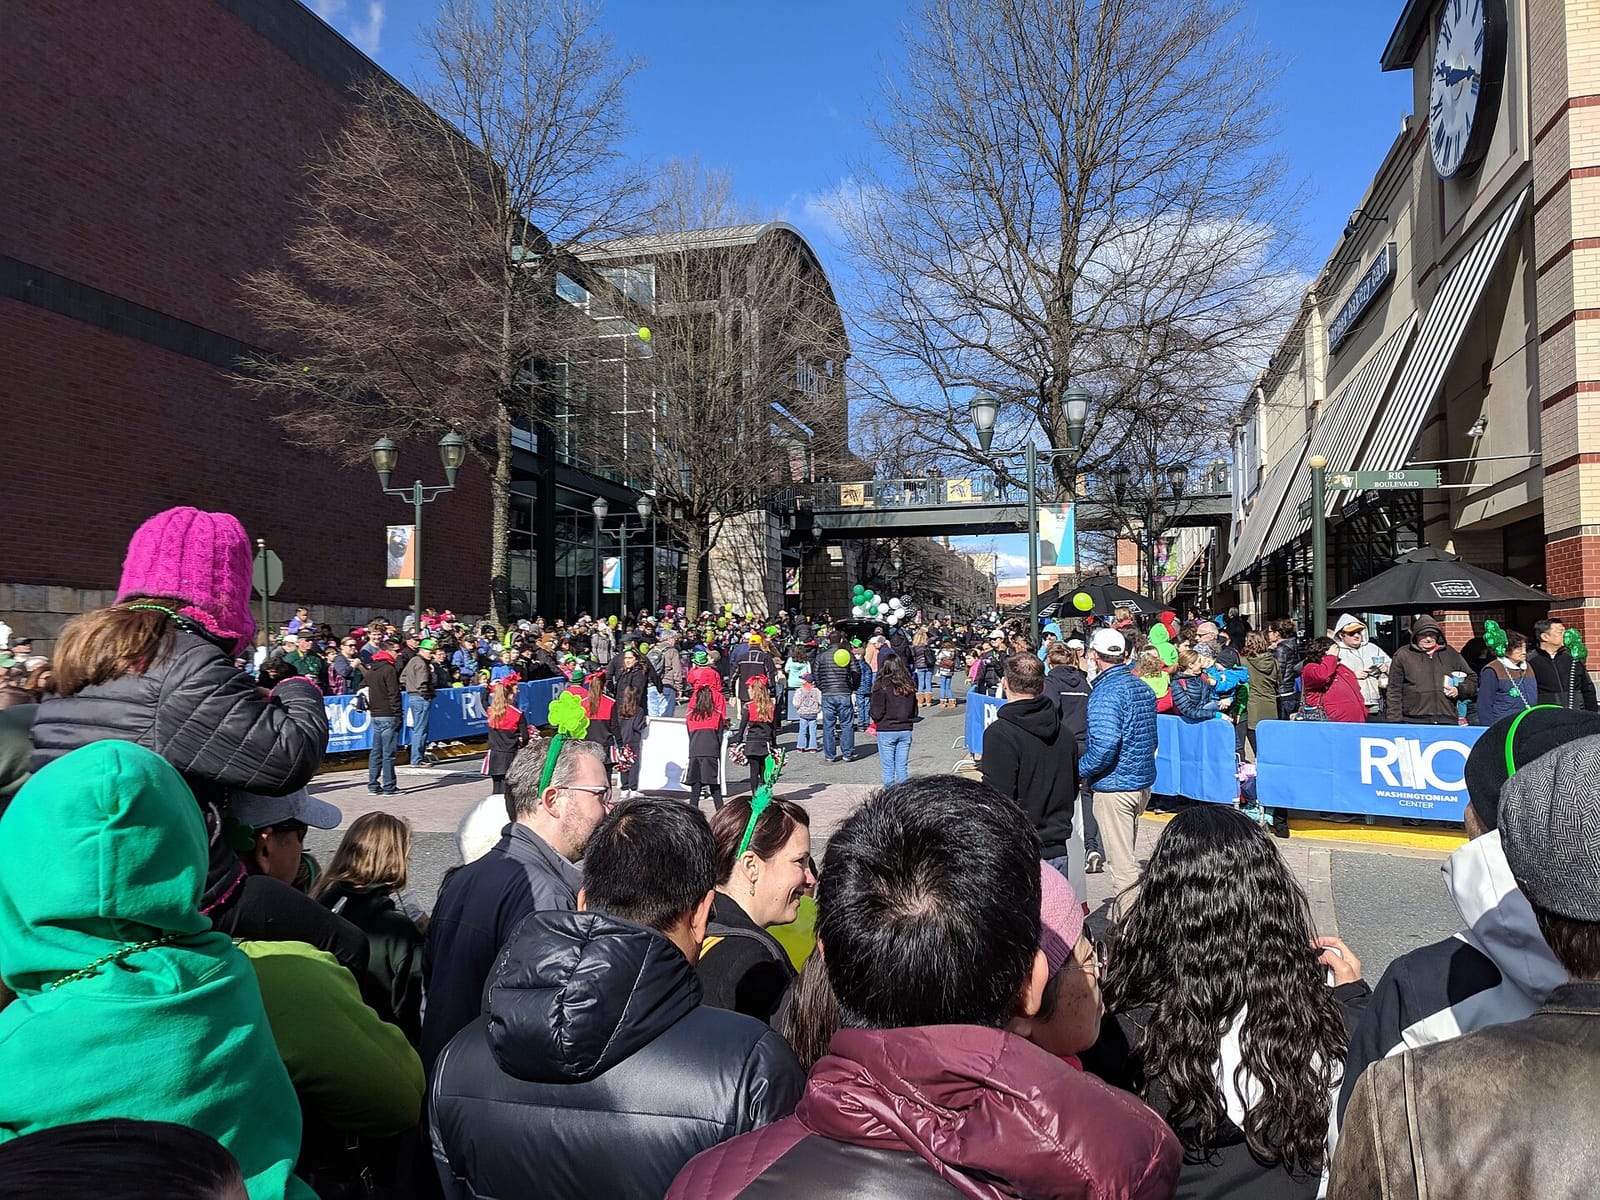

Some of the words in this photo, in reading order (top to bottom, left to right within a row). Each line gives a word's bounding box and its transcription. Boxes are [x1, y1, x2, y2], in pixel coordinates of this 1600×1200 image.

[1388, 471, 1405, 480] RIO
[1376, 790, 1458, 803] WASHINGTONIAN
[1399, 800, 1434, 809] CENTER
